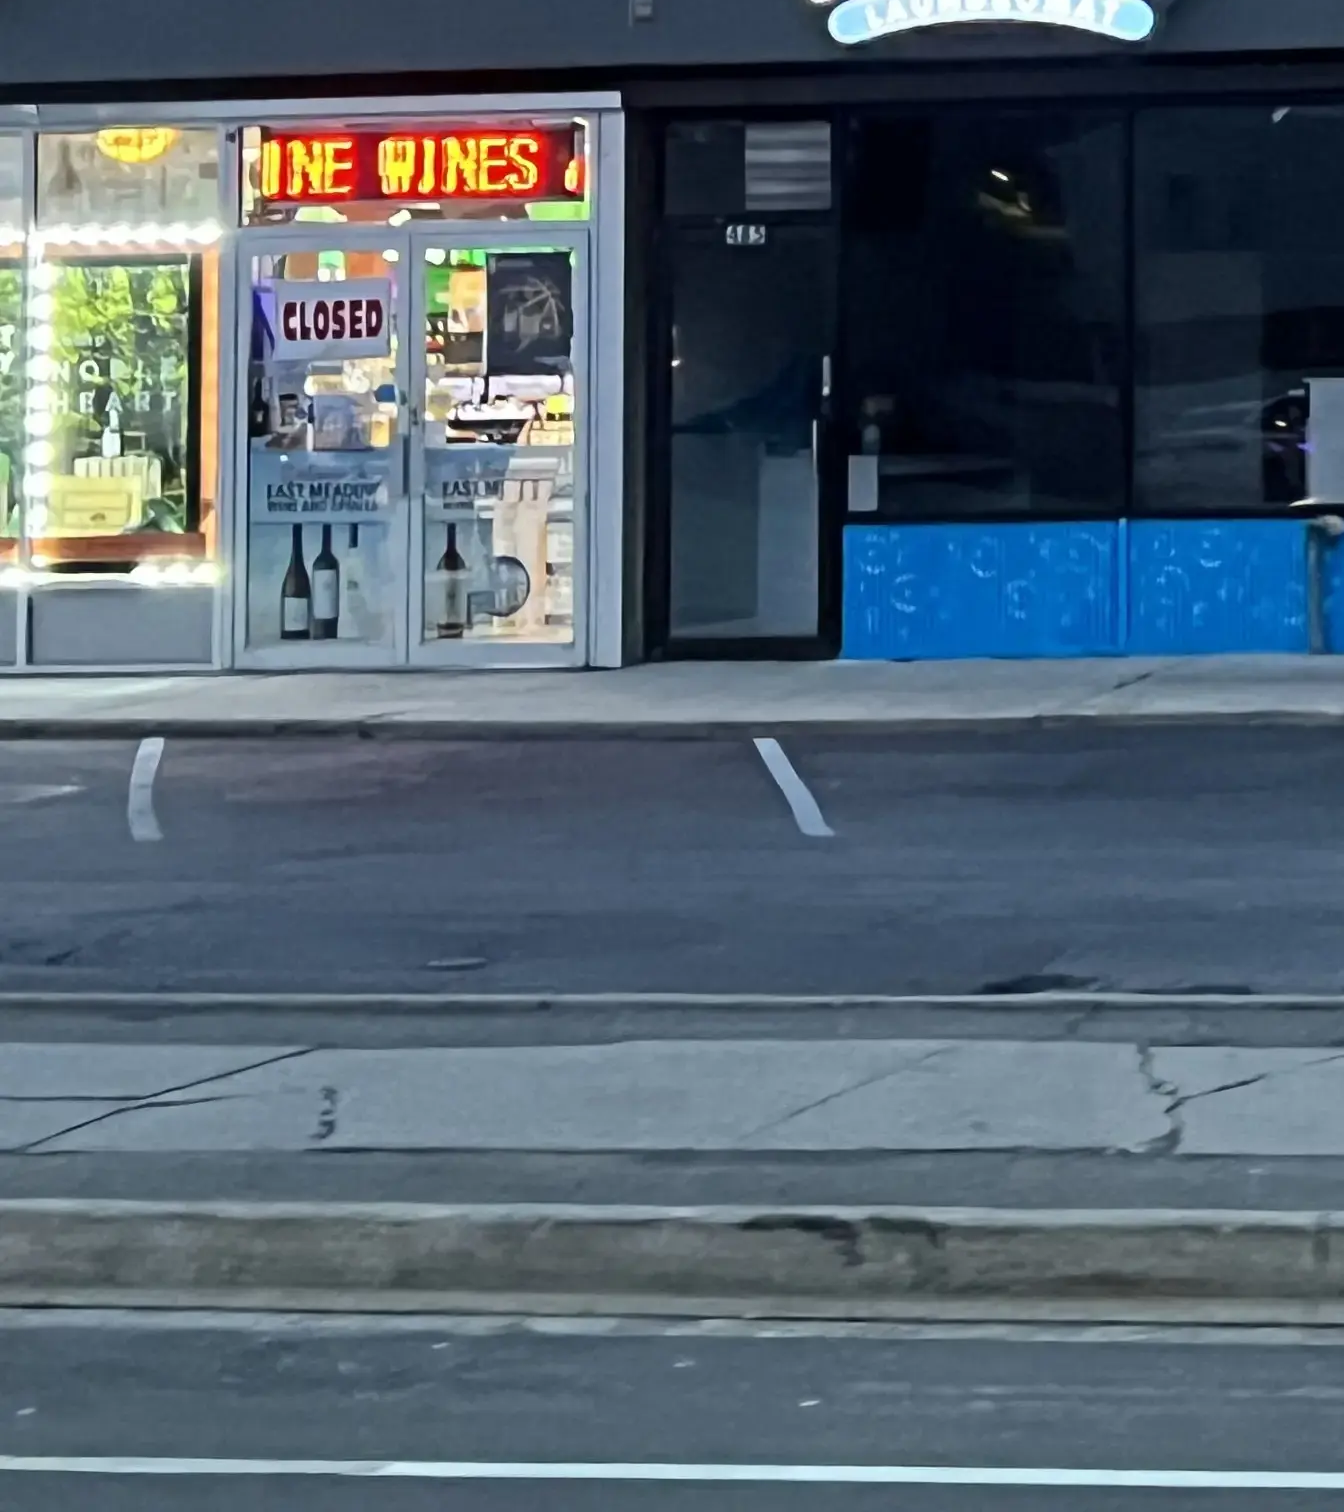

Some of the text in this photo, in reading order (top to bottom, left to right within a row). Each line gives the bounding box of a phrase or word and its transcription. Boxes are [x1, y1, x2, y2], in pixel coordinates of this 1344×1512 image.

[262, 136, 539, 197] INE WINES
[282, 298, 384, 342] CLOSED
